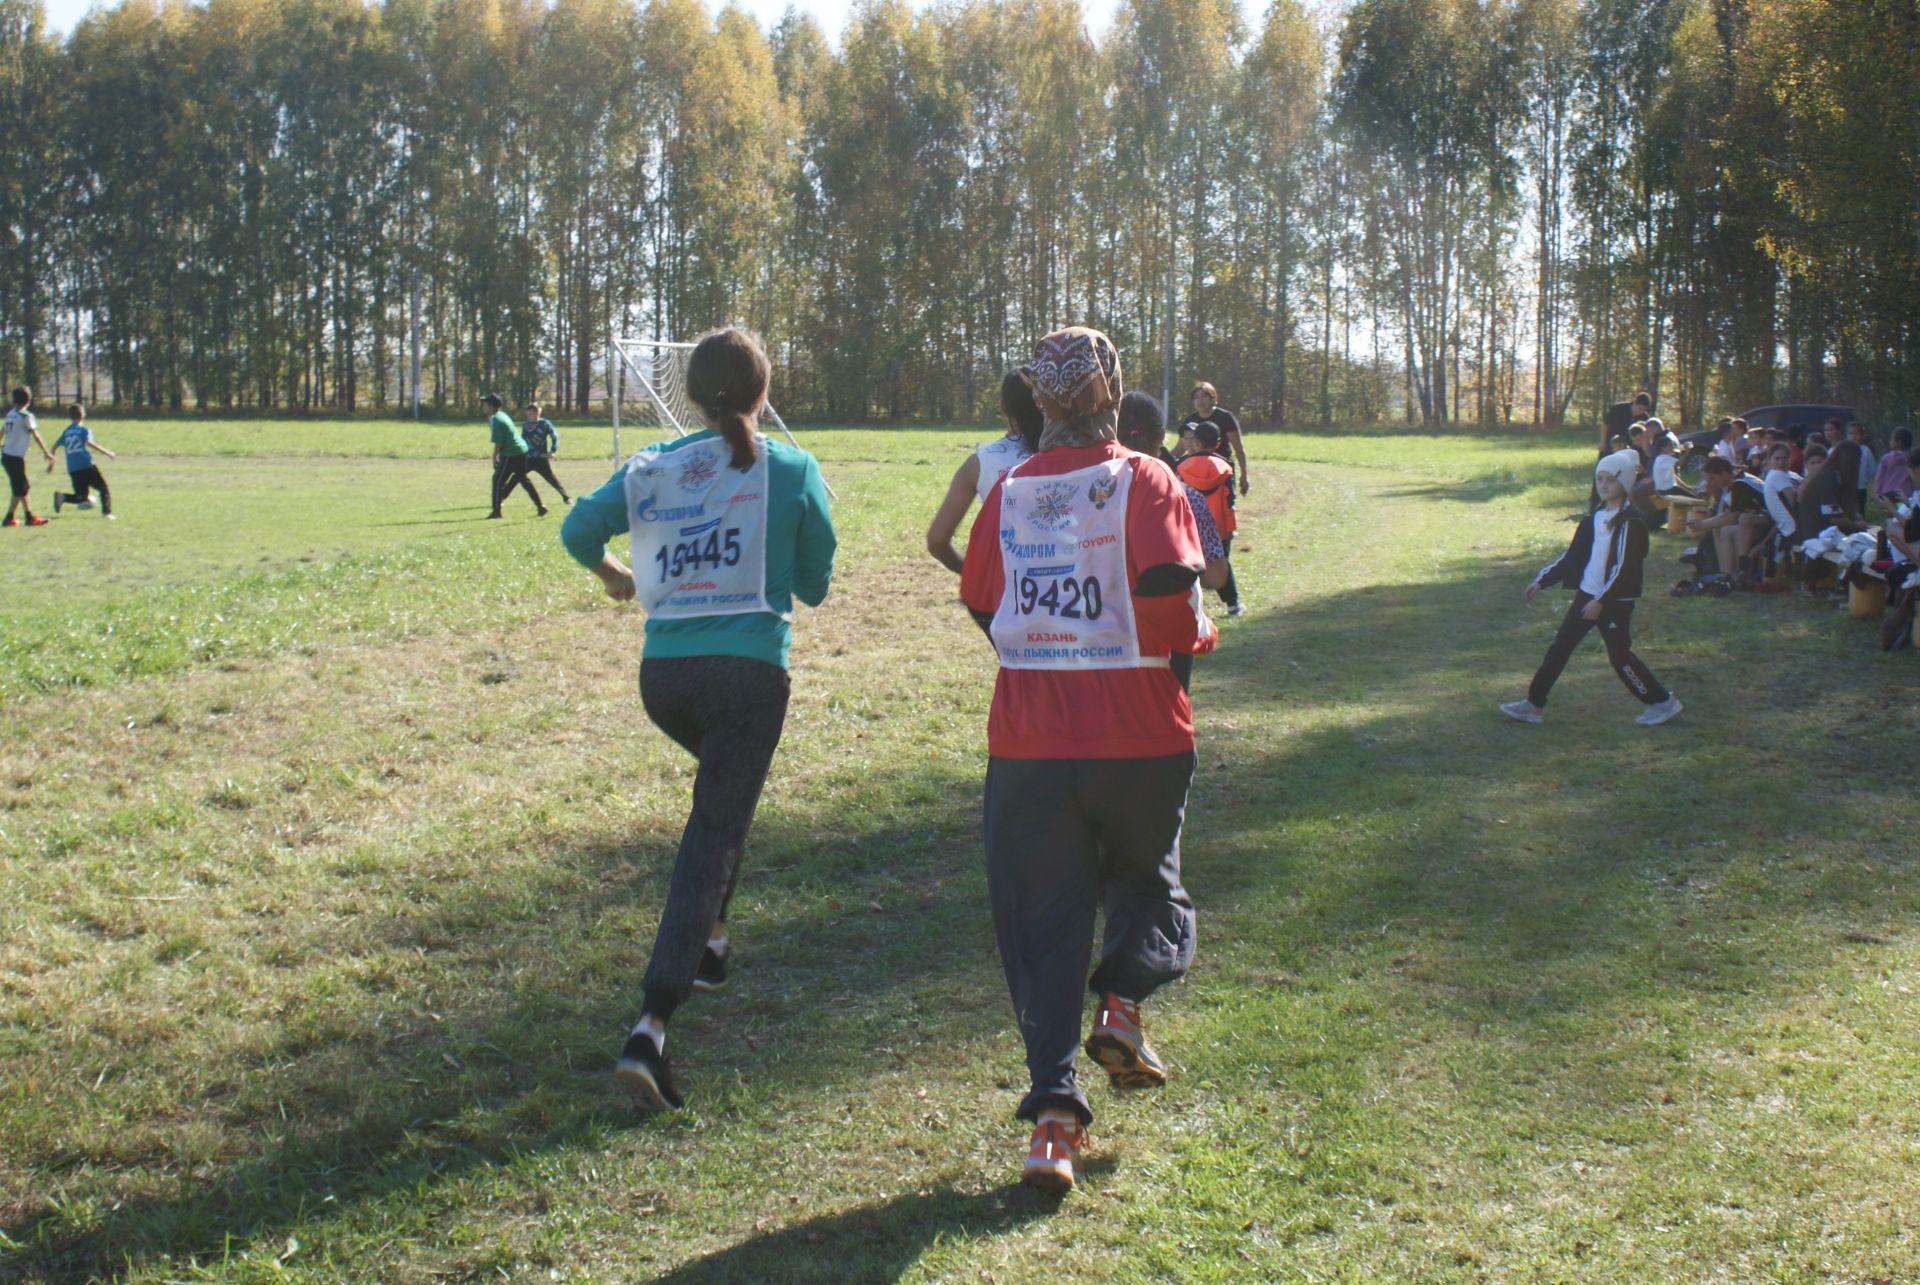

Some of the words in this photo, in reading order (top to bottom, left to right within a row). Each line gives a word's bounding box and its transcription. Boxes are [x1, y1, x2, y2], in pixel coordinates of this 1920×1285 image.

[65, 435, 83, 454] 22
[1078, 534, 1117, 550] TOYOTA
[1014, 569, 1103, 620] 19420
[1026, 632, 1078, 643] КАЗАНЬ
[1023, 647, 1069, 659] ЛЫЖНЯ
[1072, 645, 1124, 658] РОССИИ
